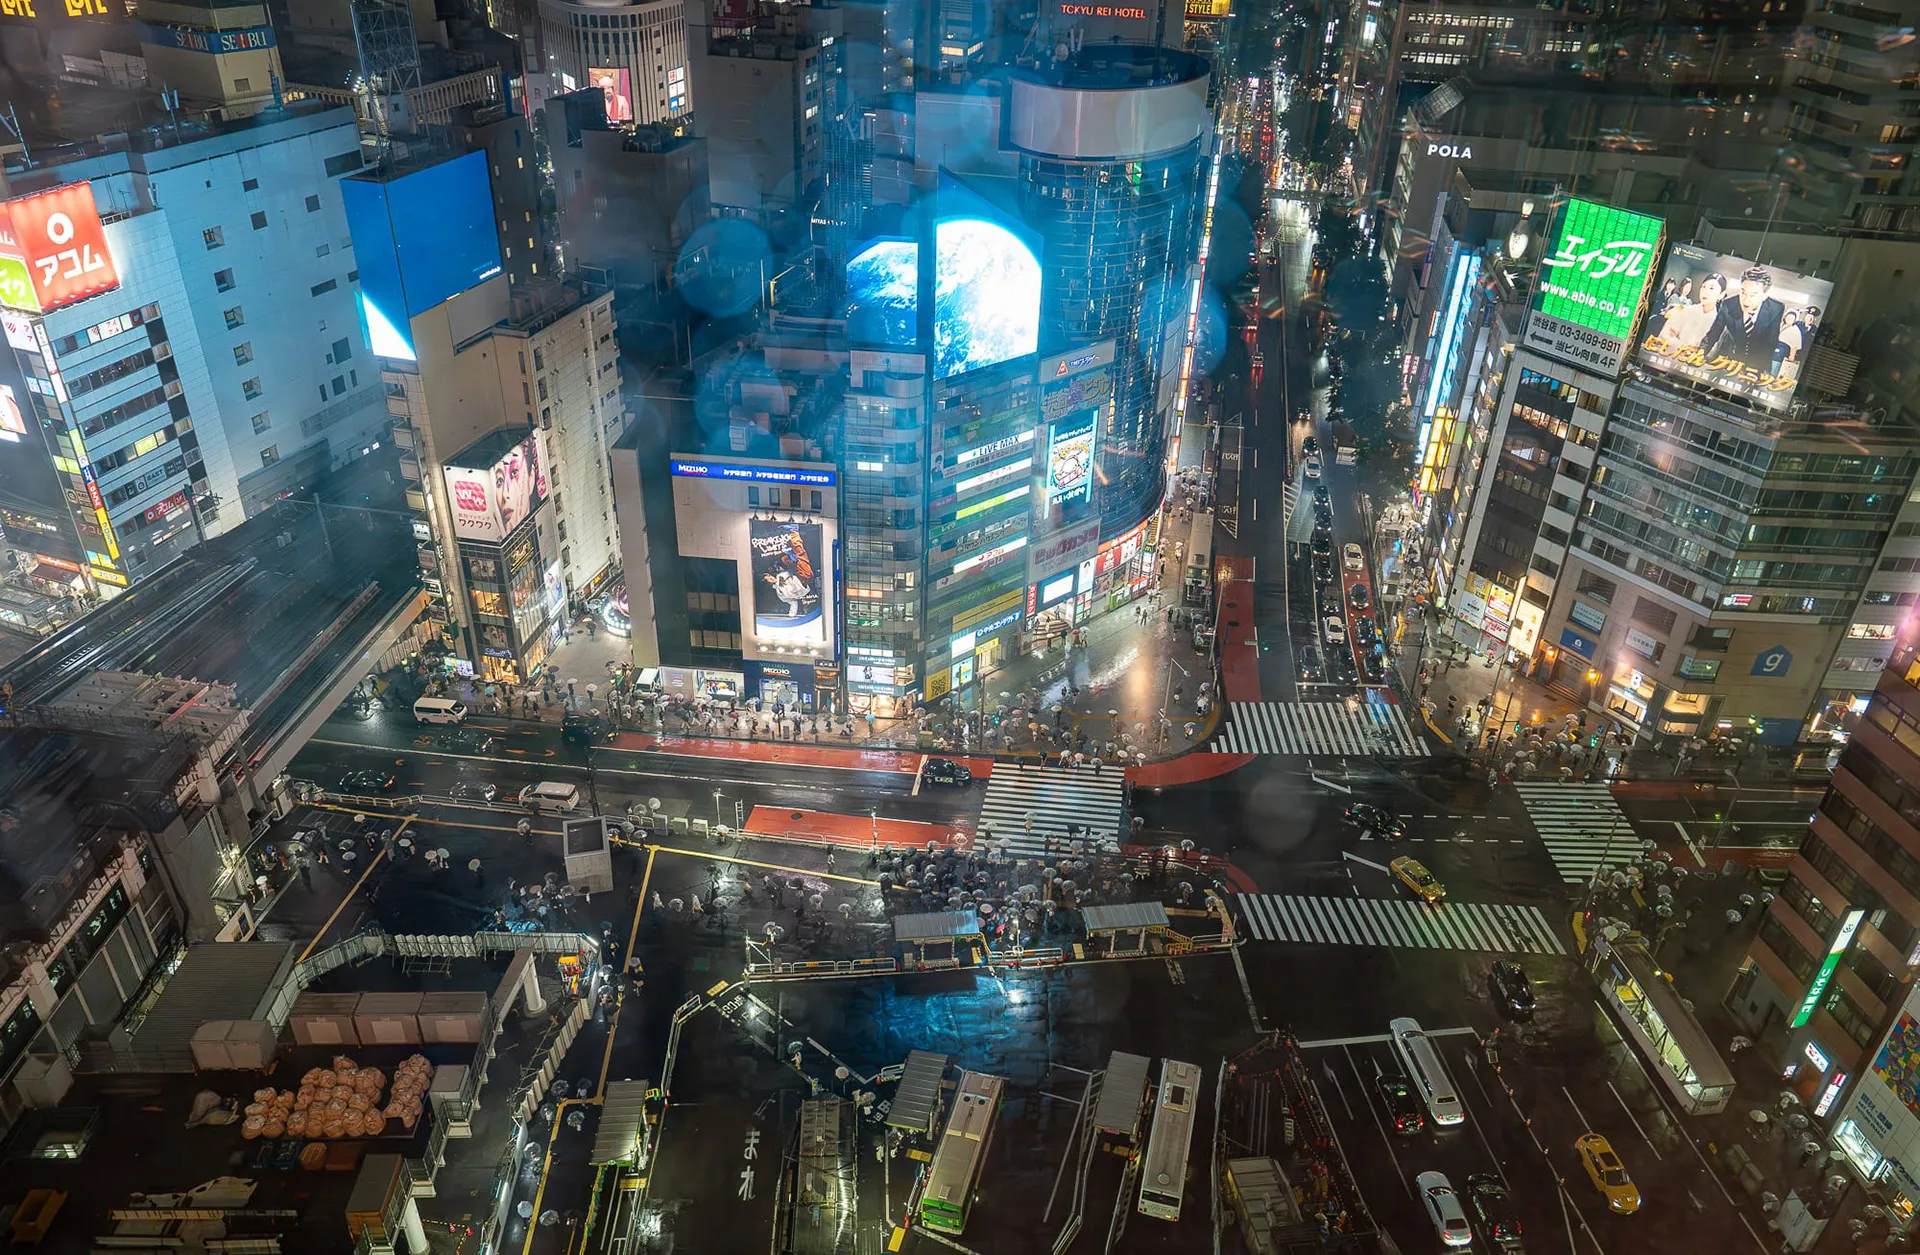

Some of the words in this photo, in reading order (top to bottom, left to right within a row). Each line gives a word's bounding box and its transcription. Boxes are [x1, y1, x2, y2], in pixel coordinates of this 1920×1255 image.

[1061, 4, 1094, 16] TOKYU
[1096, 7, 1112, 17] REI
[1114, 8, 1145, 19] HOTEL
[1188, 4, 1212, 15] STYLE
[220, 31, 267, 52] SEIBU
[1427, 144, 1472, 159] POLA
[35, 244, 105, 288] アコム
[1542, 235, 1652, 279] エイブル
[1540, 281, 1630, 318] www.able.co.jp
[1532, 315, 1559, 333] 渋谷店
[1559, 324, 1621, 355] 03-3499-8911
[979, 444, 998, 456] LIVE
[999, 435, 1020, 449] MAX
[458, 518, 492, 530] ワクワク
